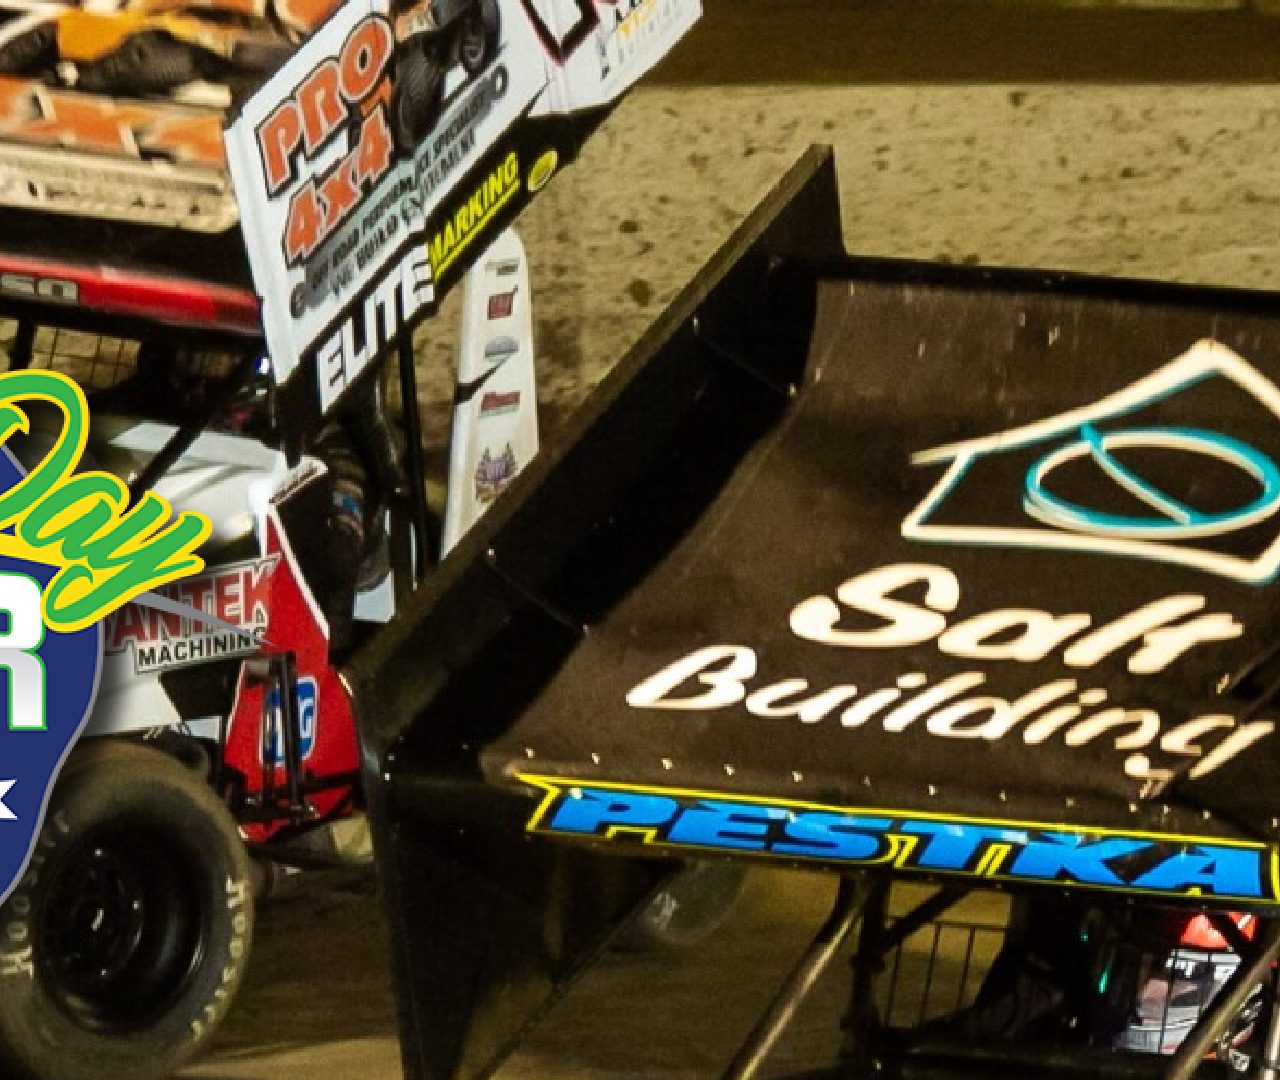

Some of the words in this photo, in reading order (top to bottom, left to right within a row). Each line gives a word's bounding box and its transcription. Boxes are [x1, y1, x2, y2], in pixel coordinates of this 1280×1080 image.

[320, 243, 435, 414] ELITE
[427, 151, 519, 268] MARKING
[106, 563, 273, 645] ANTEK
[138, 627, 266, 666] MACHINING
[625, 643, 1276, 784] Building
[549, 786, 1263, 897] PESTKA
